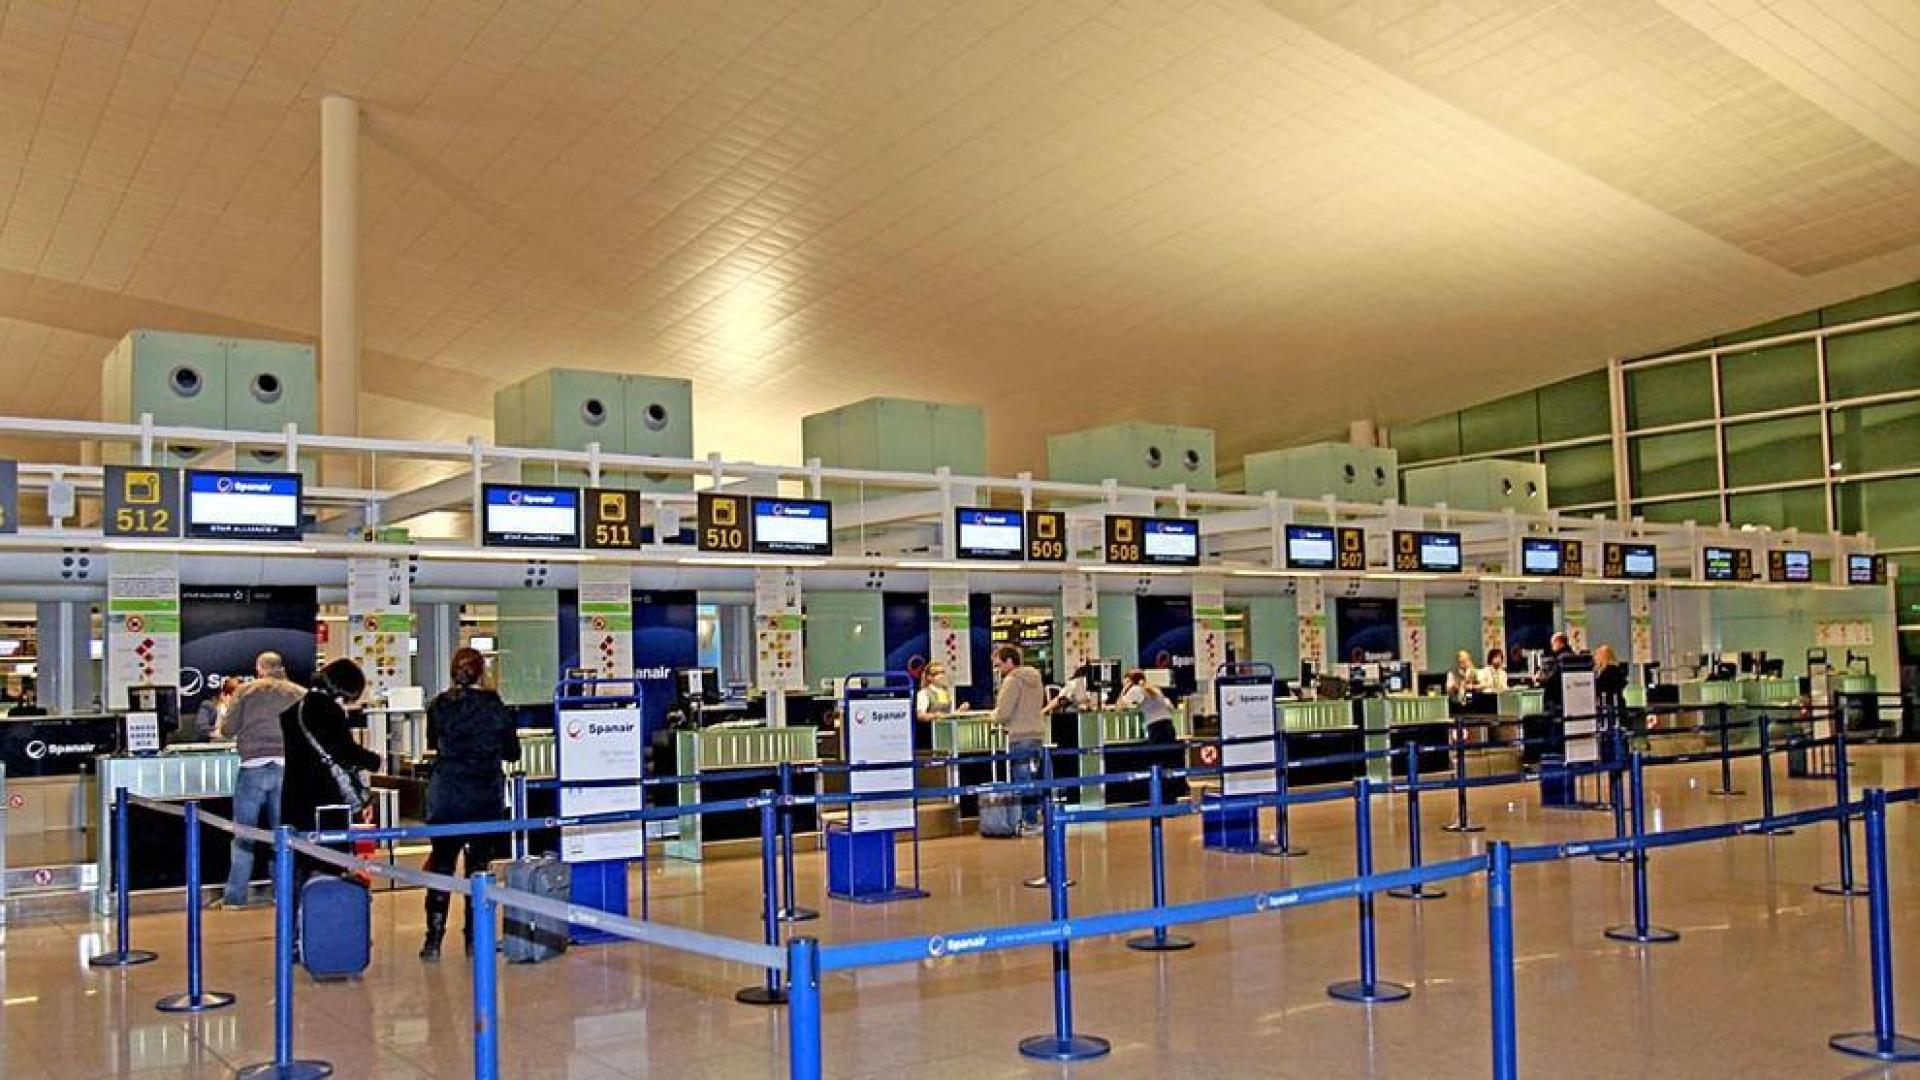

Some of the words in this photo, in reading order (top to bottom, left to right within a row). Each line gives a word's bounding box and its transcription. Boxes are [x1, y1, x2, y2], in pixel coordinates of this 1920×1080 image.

[234, 481, 272, 493] Spanair
[116, 507, 170, 532] 512
[596, 525, 631, 545] 511
[707, 528, 742, 548] 510
[1031, 540, 1062, 557] 509
[1110, 544, 1140, 561] 508
[871, 710, 906, 722] Spanair
[588, 723, 634, 735] Spanair
[48, 743, 96, 755] Spanair
[947, 935, 986, 951] Spanair
